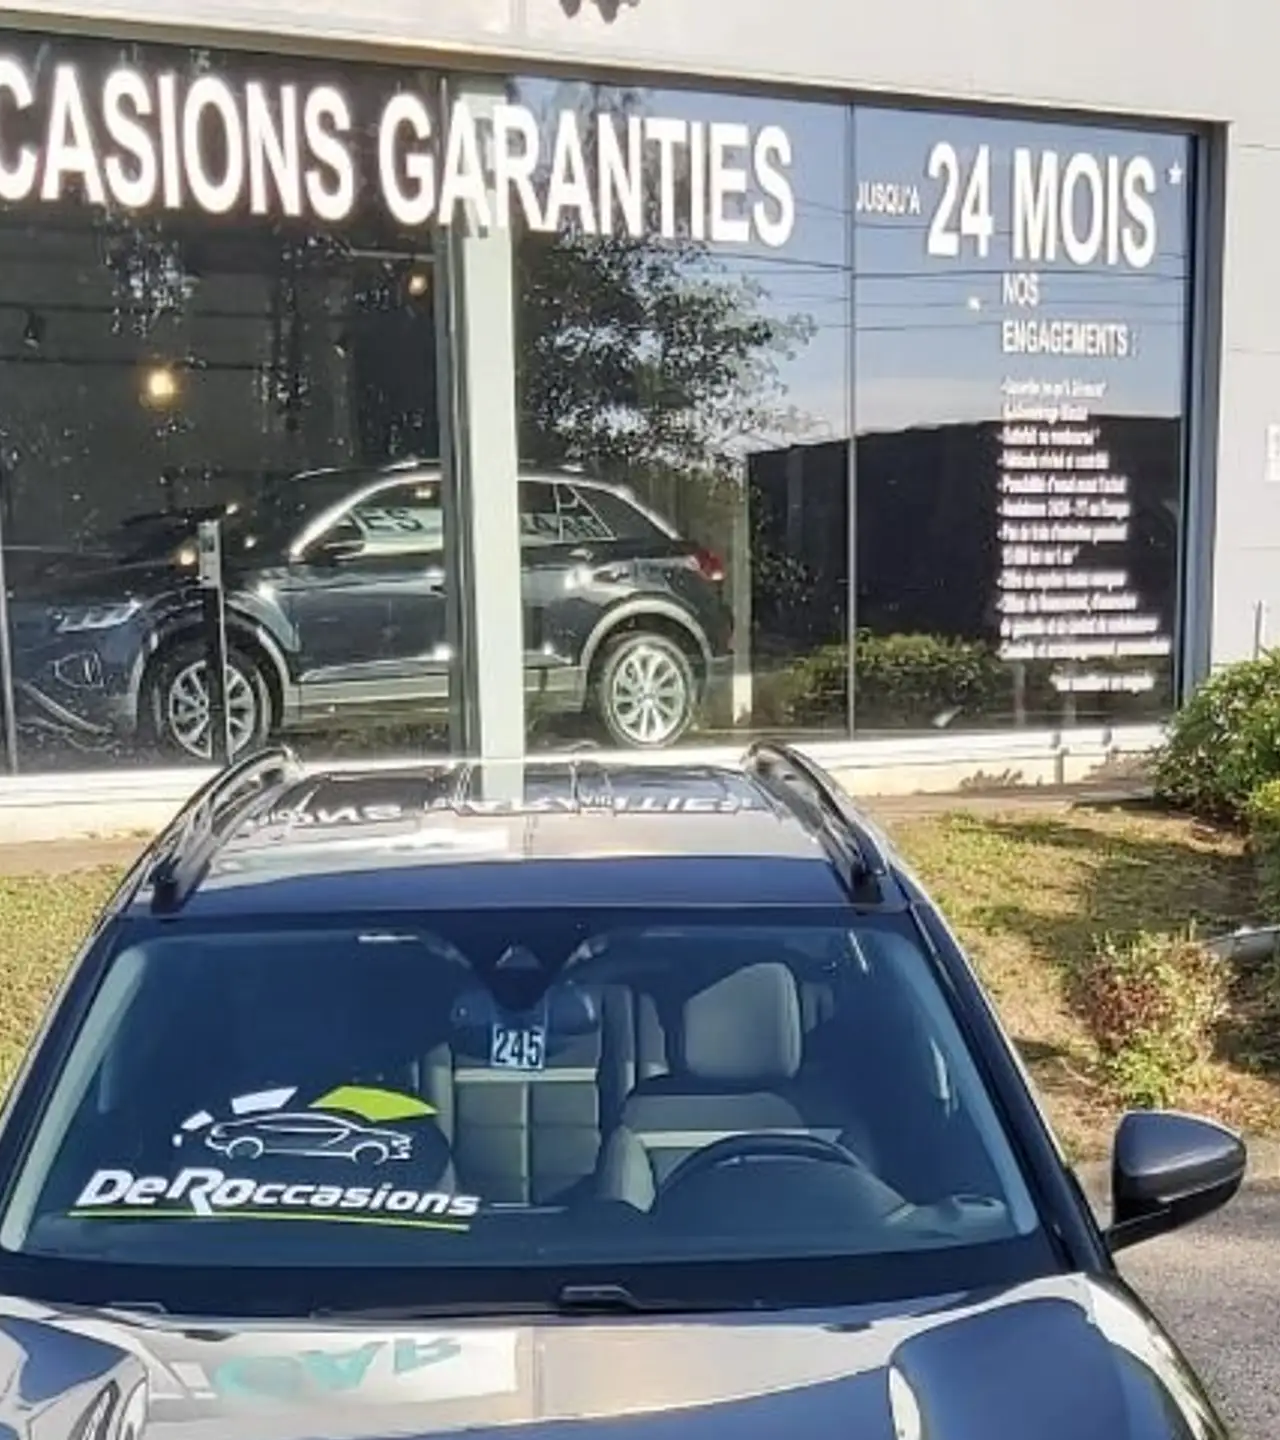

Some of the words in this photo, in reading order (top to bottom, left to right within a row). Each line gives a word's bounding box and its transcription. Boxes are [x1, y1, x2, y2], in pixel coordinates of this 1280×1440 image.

[377, 90, 795, 247] GARANTIES
[927, 140, 994, 259] 24
[1013, 147, 1158, 269] MOIS
[1002, 272, 1039, 307] NOS
[494, 1027, 543, 1067] 245
